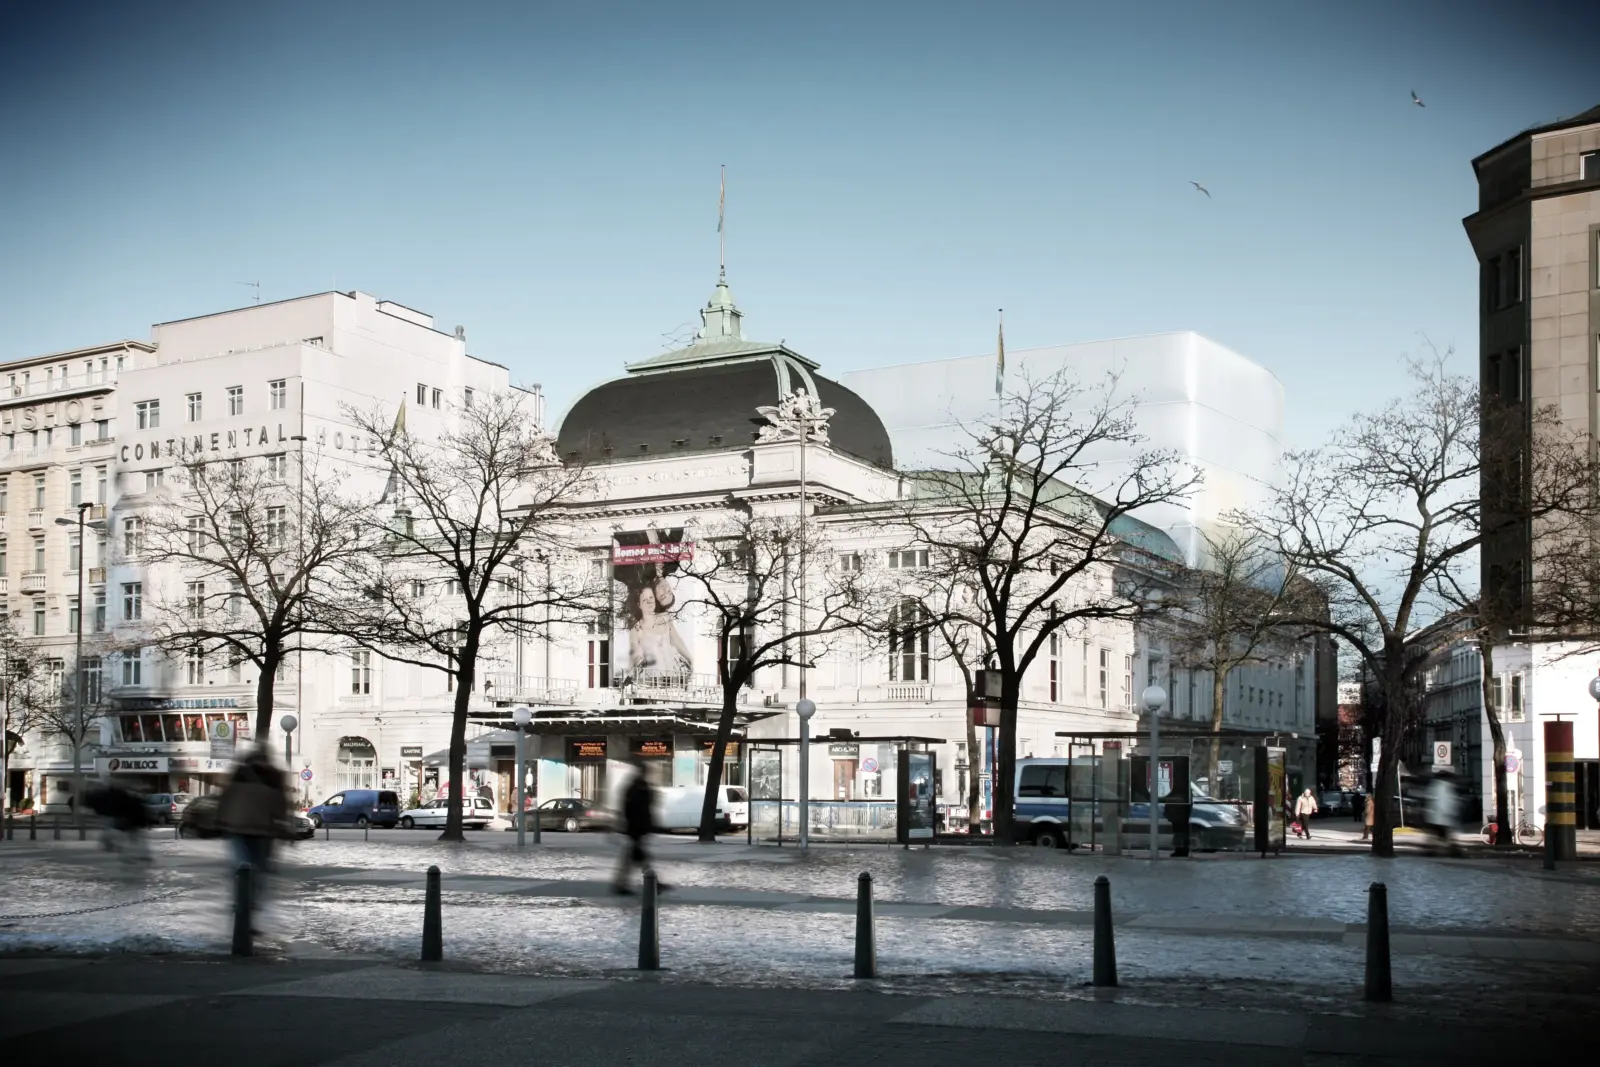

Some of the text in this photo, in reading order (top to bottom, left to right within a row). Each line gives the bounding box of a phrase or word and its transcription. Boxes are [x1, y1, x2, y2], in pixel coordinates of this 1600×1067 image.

[120, 423, 389, 463] CONTINENTAL HOTE
[615, 547, 646, 558] Romeo
[647, 544, 666, 555] und
[133, 760, 159, 769] BLOCK
